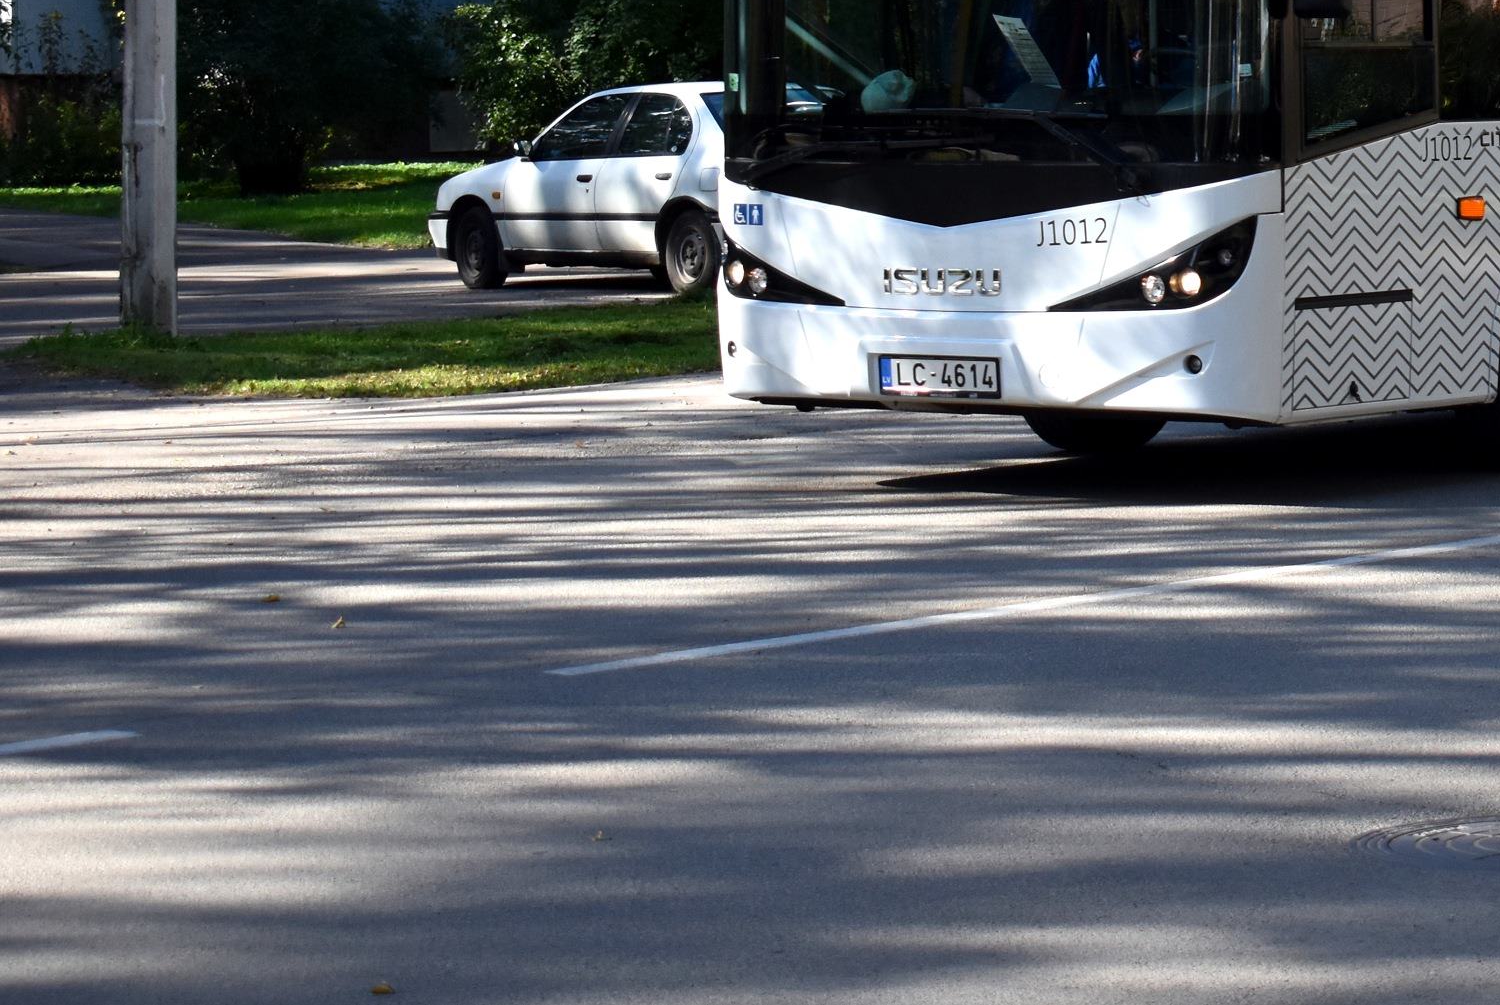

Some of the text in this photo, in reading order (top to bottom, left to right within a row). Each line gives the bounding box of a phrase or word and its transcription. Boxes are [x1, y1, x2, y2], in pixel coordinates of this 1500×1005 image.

[1422, 134, 1473, 163] J1012
[1036, 217, 1108, 247] J1012
[883, 267, 1001, 296] ISUZU
[896, 362, 994, 389] LC-4614
